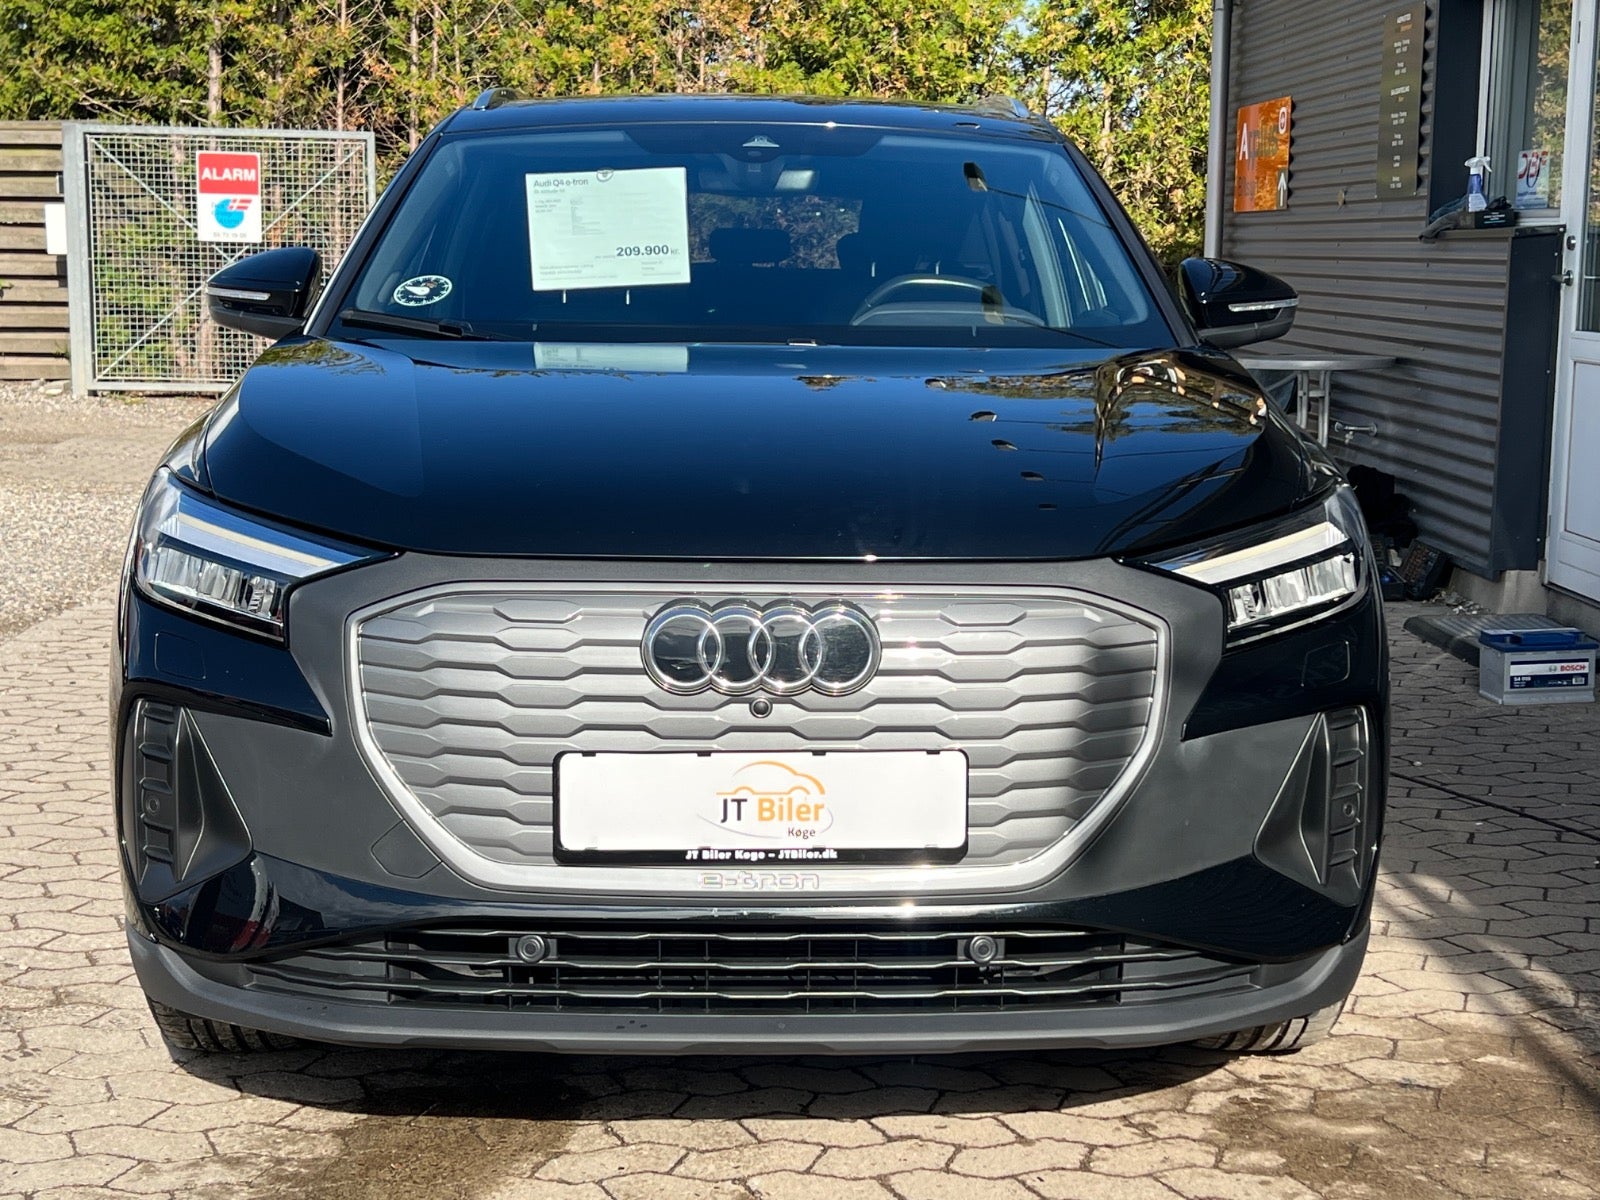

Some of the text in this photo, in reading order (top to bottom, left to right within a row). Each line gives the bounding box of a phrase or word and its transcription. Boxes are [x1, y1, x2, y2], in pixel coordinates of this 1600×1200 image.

[201, 167, 256, 181] ALARM
[616, 245, 669, 257] 209.900
[720, 797, 825, 824] JT Biler
[787, 827, 816, 840] Køge
[685, 850, 699, 860] JT
[702, 850, 732, 860] Biler
[778, 849, 838, 860] JTBiler.dk
[701, 871, 820, 890] e-tron
